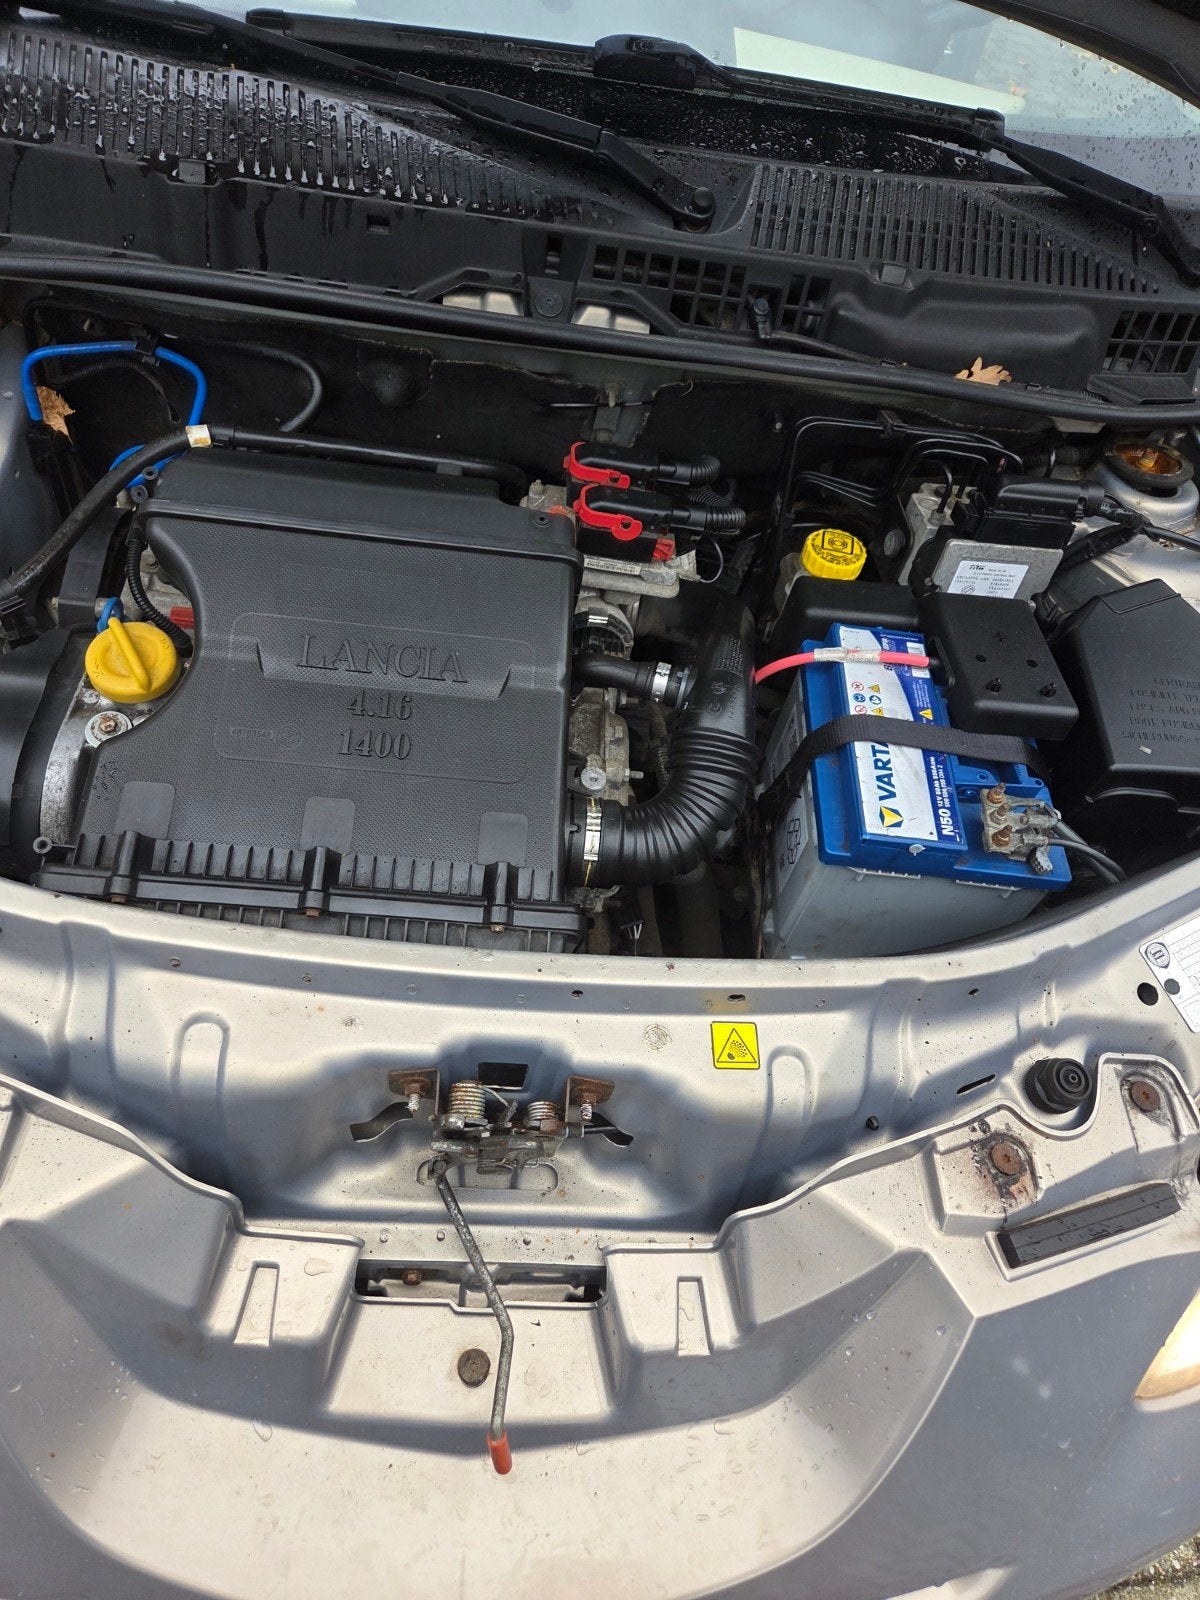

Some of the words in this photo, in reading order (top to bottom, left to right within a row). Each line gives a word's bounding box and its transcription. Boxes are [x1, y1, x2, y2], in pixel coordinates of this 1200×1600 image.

[297, 635, 468, 683] LANCIA
[347, 688, 413, 720] 4.16
[338, 731, 412, 760] 1400
[939, 808, 955, 836] N50
